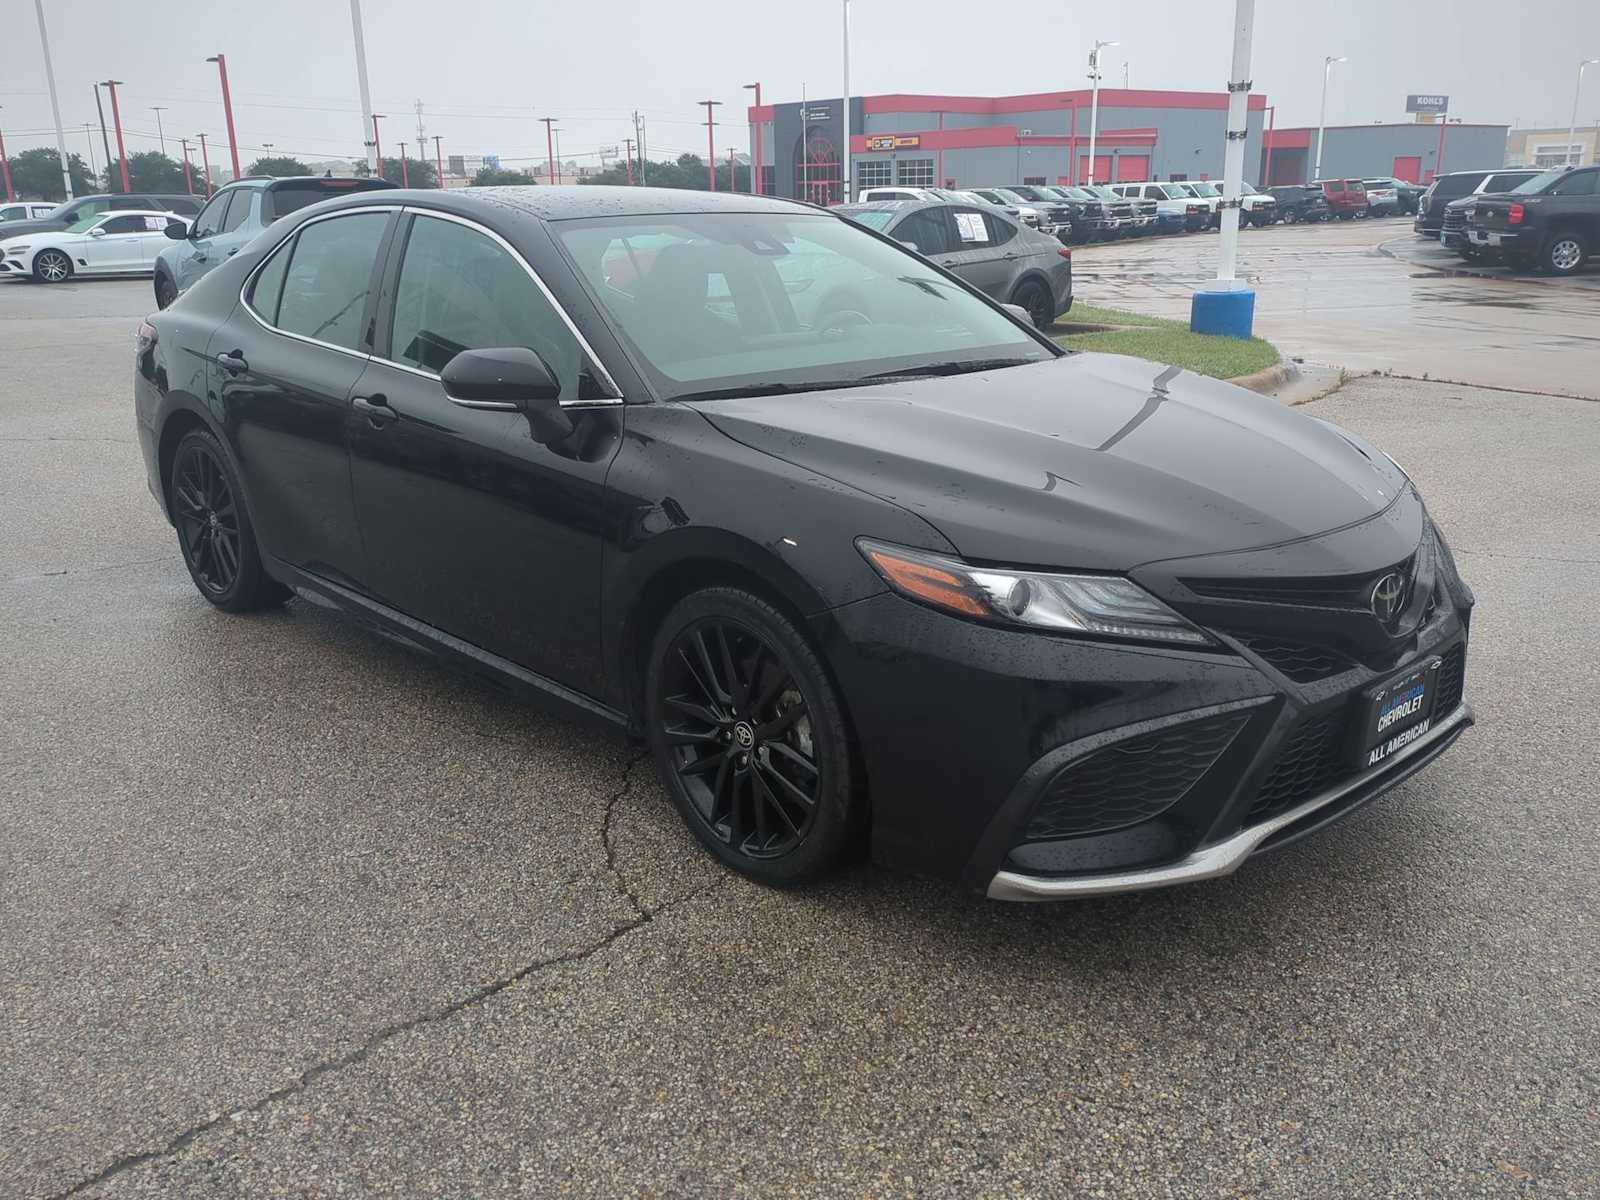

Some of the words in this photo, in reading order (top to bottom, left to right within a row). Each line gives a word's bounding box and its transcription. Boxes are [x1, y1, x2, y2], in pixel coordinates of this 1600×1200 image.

[1377, 694, 1424, 733] CHEVROLET
[1368, 747, 1386, 767] ALL
[1387, 719, 1430, 755] AMERICAN
